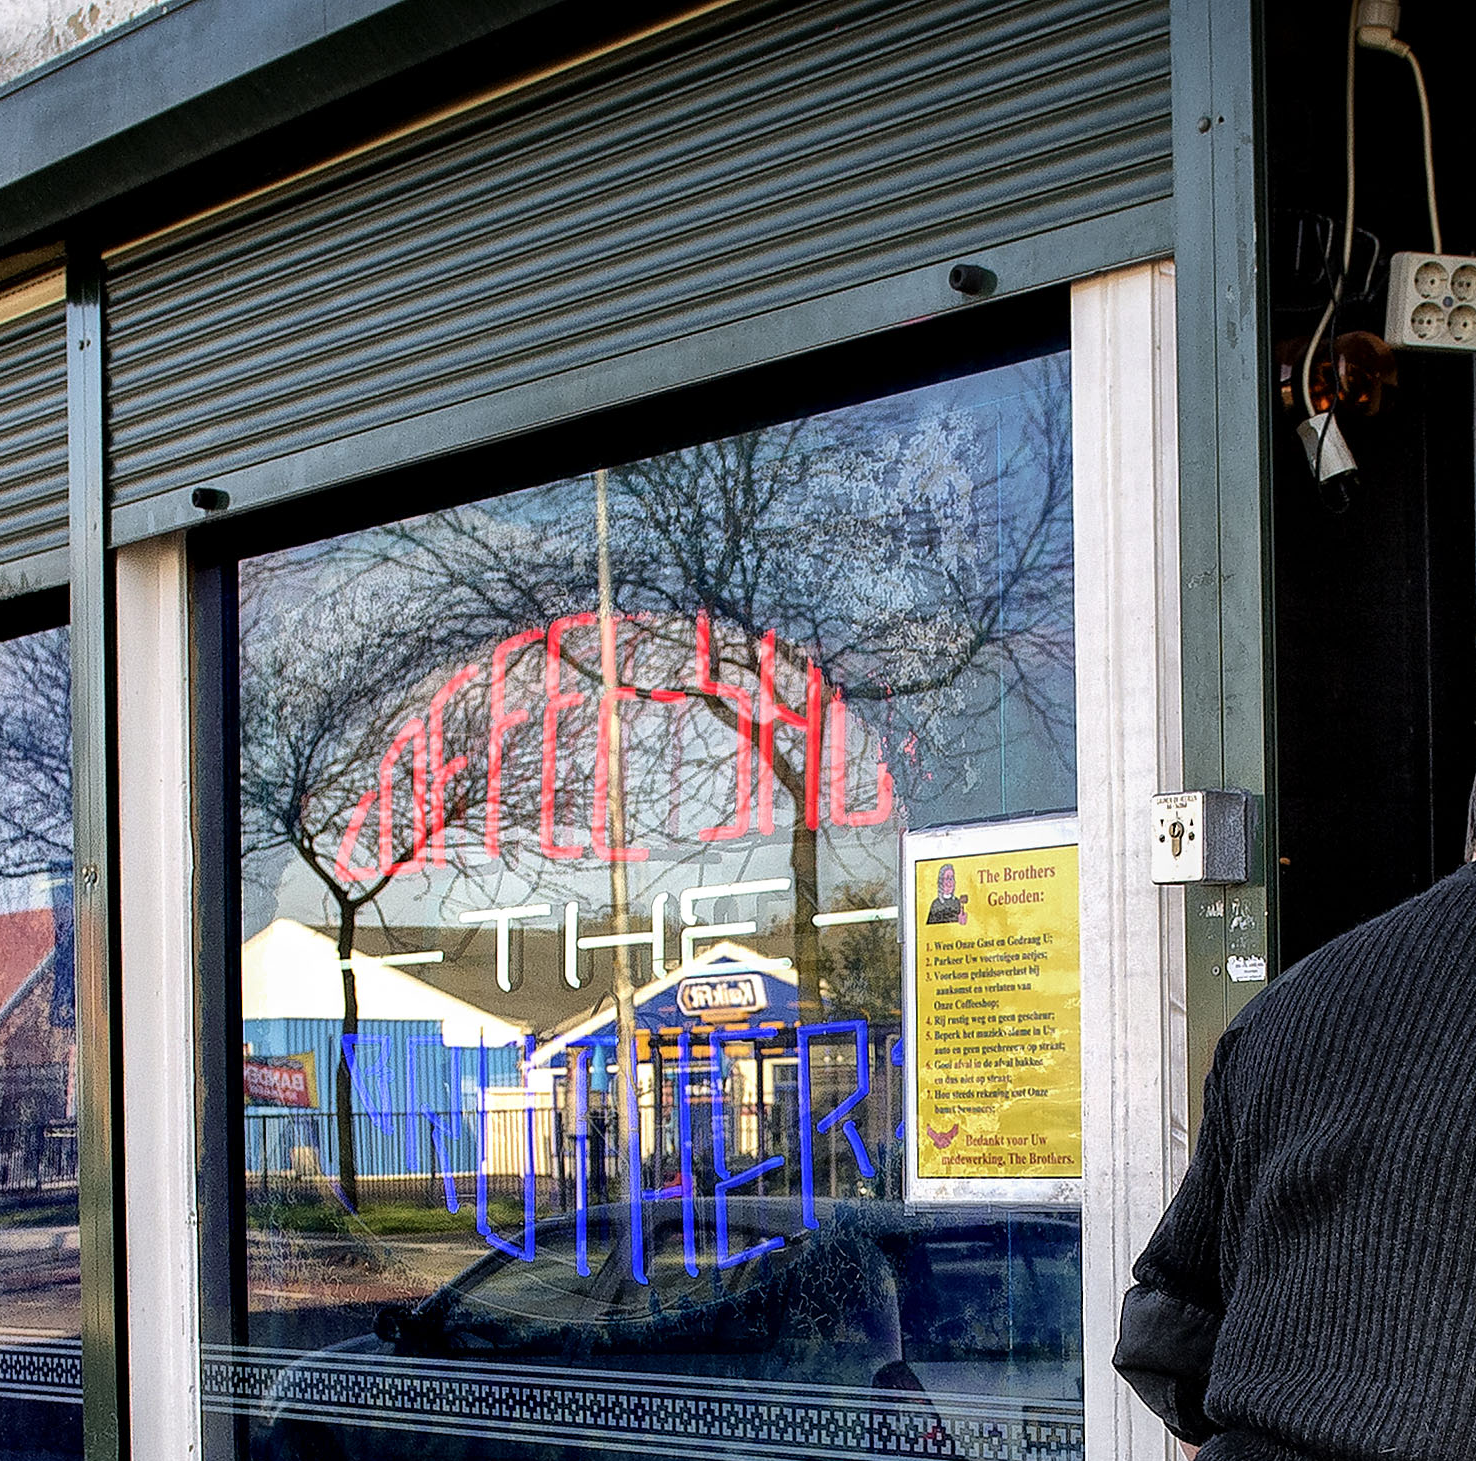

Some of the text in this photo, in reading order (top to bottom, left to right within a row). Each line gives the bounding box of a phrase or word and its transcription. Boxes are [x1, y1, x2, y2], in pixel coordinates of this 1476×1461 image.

[697, 606, 913, 842] SHO
[977, 865, 1056, 884] The Brothers
[987, 889, 1045, 907] Geboden:
[459, 878, 792, 992] THE
[956, 940, 975, 950] Onze
[977, 938, 994, 948] Gast
[996, 939, 1005, 947] en
[1007, 935, 1041, 946] Gedraag
[934, 955, 963, 966] Parkeer
[966, 954, 977, 964] Uw
[980, 952, 1020, 963] voertuigen
[934, 970, 969, 980] Voorkom
[971, 966, 1026, 980] geluidsoverlast
[1029, 965, 1040, 976] bij
[936, 985, 972, 995] aankomst
[985, 983, 1015, 993] verlaten
[934, 1001, 953, 1010] Onze
[934, 1015, 946, 1027] Rij
[948, 1014, 969, 1025] rustig
[971, 1016, 986, 1025] weg
[998, 1014, 1015, 1024] geen
[934, 1029, 960, 1042] Beperk
[963, 1028, 975, 1038] het
[1033, 1026, 1040, 1035] in
[935, 1047, 950, 1055] auto
[963, 1046, 980, 1055] geen
[1027, 1043, 1037, 1053] op
[934, 1060, 952, 1069] Gooi
[954, 1058, 972, 1069] afval
[974, 1059, 981, 1068] in
[983, 1059, 992, 1067] de
[994, 1058, 1013, 1067] afval
[945, 1075, 958, 1084] dus
[961, 1074, 974, 1083] niet
[976, 1076, 985, 1085] op
[934, 1089, 950, 1099] Hou
[952, 1089, 974, 1099] steeds
[977, 1088, 1010, 1099] rekening
[1028, 1088, 1048, 1097] Onze
[965, 1133, 1047, 1147] Bedankt voor Uw
[339, 1020, 904, 1284] BROTHER
[941, 1152, 1075, 1167] medewerking, The Brothers.
